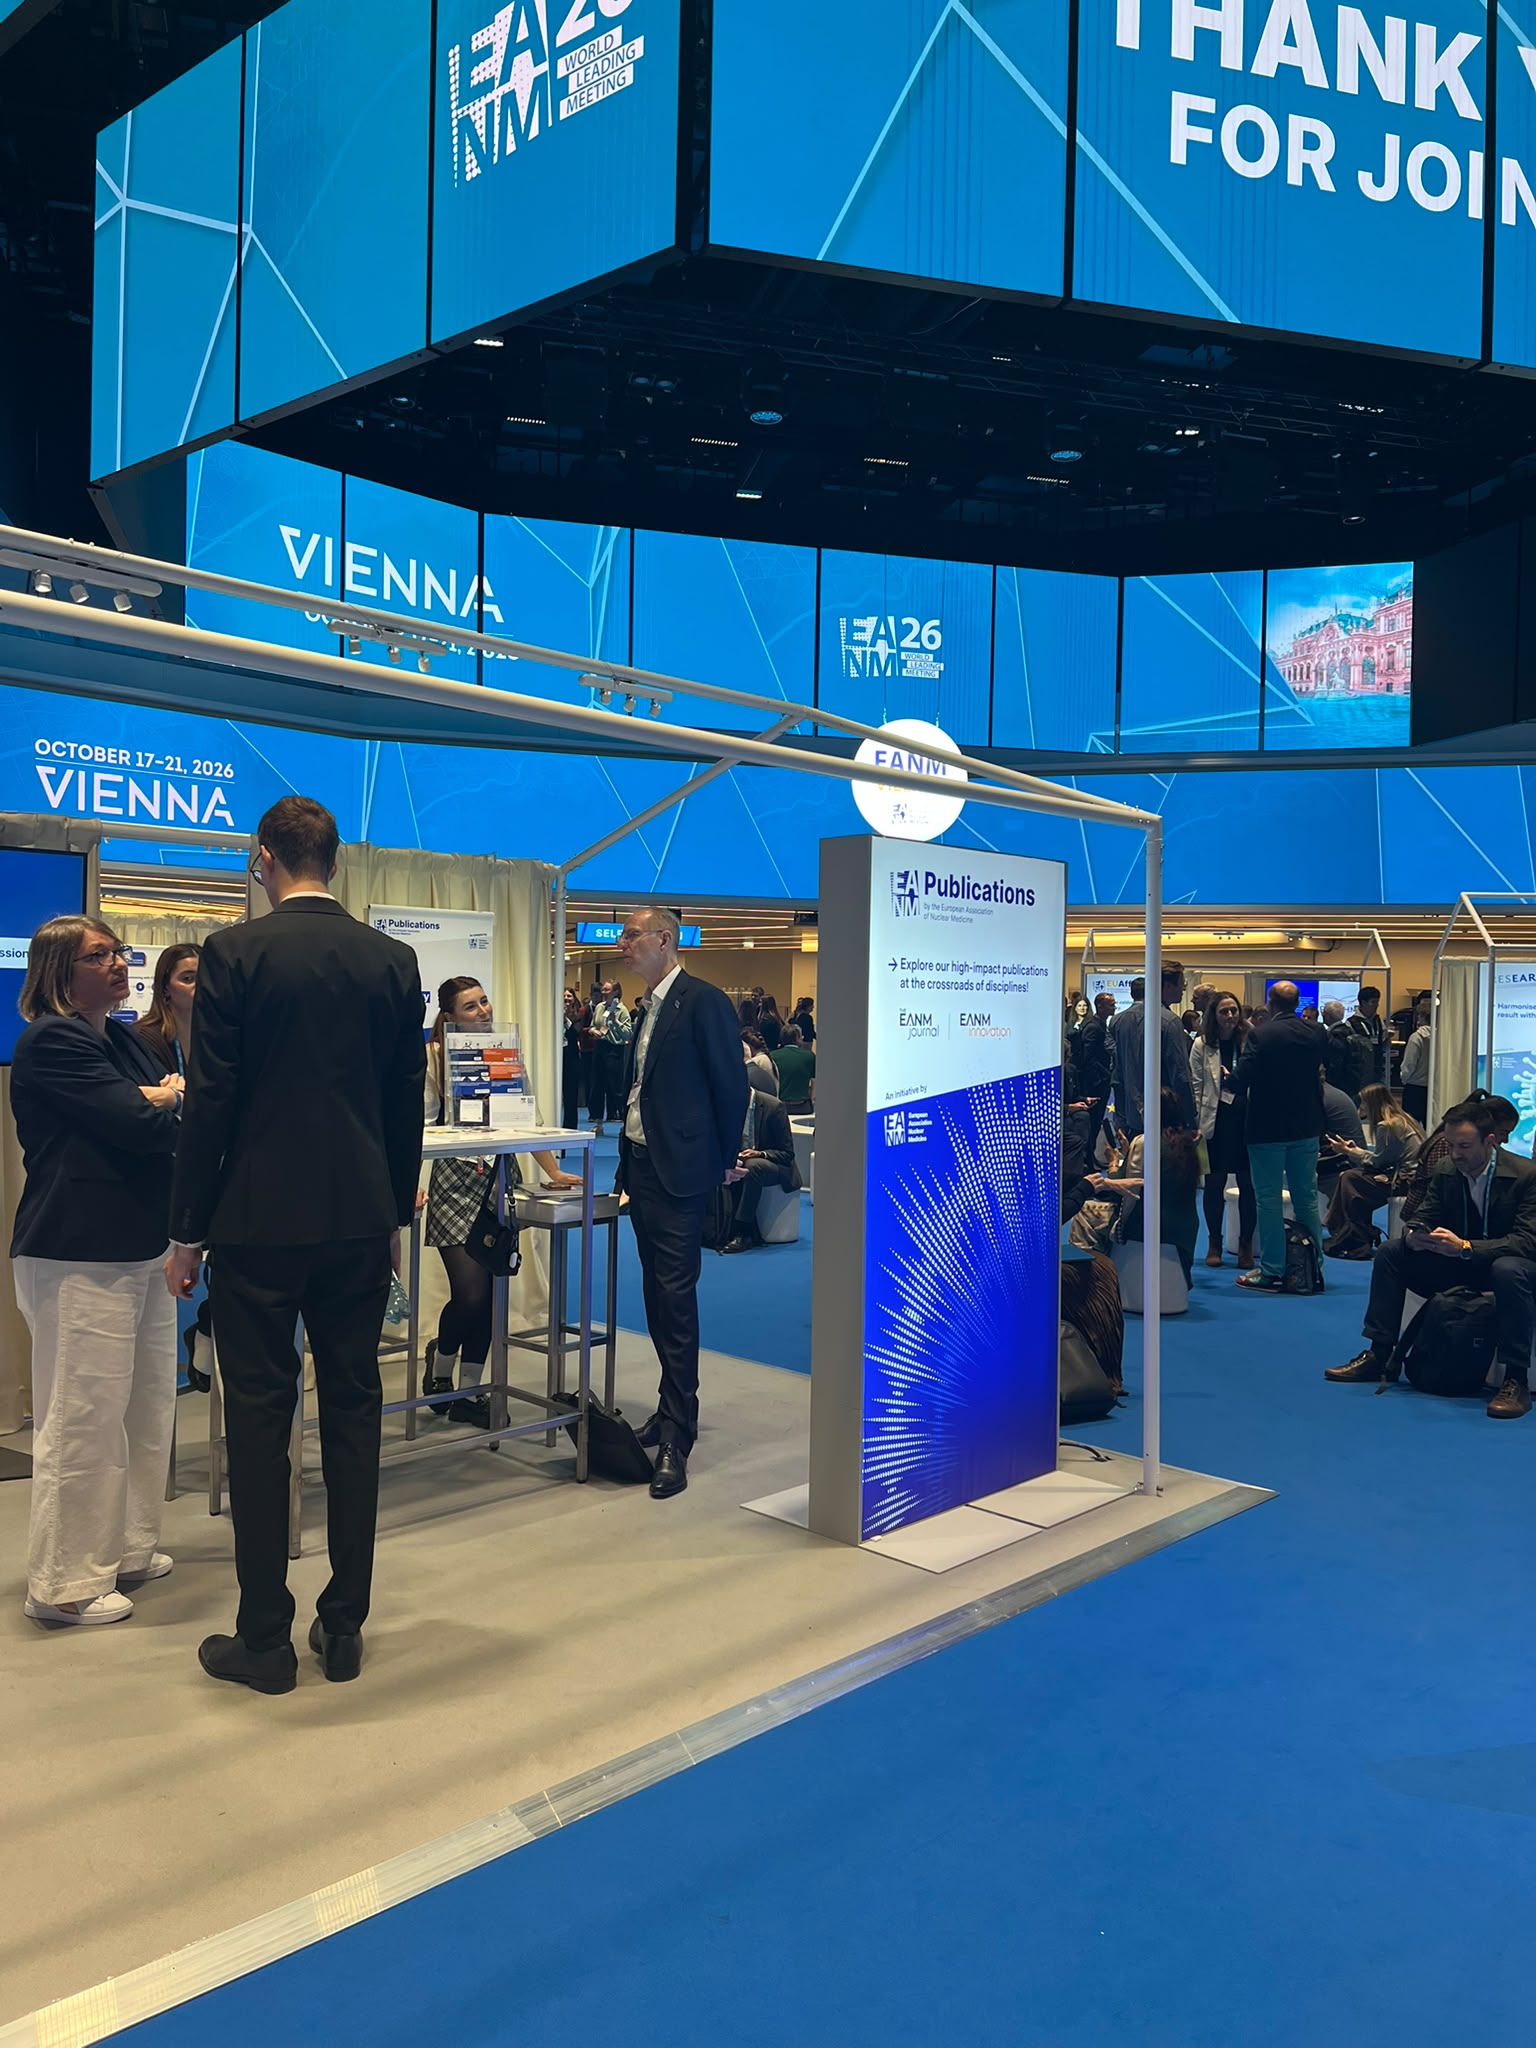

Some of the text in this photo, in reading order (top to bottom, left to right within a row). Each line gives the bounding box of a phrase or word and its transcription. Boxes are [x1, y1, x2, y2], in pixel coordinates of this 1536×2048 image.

[564, 33, 614, 72] WORLD
[576, 43, 636, 87] LEADING
[566, 69, 626, 114] MEETING
[1170, 90, 1336, 192] FOR
[279, 524, 504, 623] VIENNA
[904, 653, 930, 661] WORLD
[905, 669, 936, 678] MEETING
[910, 662, 942, 670] LEADING
[34, 738, 131, 766] OCTOBER
[192, 759, 235, 779] 2026
[35, 765, 235, 827] VIENNA
[924, 871, 1035, 906] Publications
[389, 919, 440, 930] Publications
[900, 958, 1048, 977] Explore our high-impact publications
[900, 978, 1029, 994] at the crossroads of disciplines!
[900, 1013, 932, 1026] EANM
[960, 1013, 991, 1026] EANM
[907, 1025, 939, 1040] journal
[969, 1026, 1011, 1040] innovation
[885, 1085, 927, 1100] An initiative by
